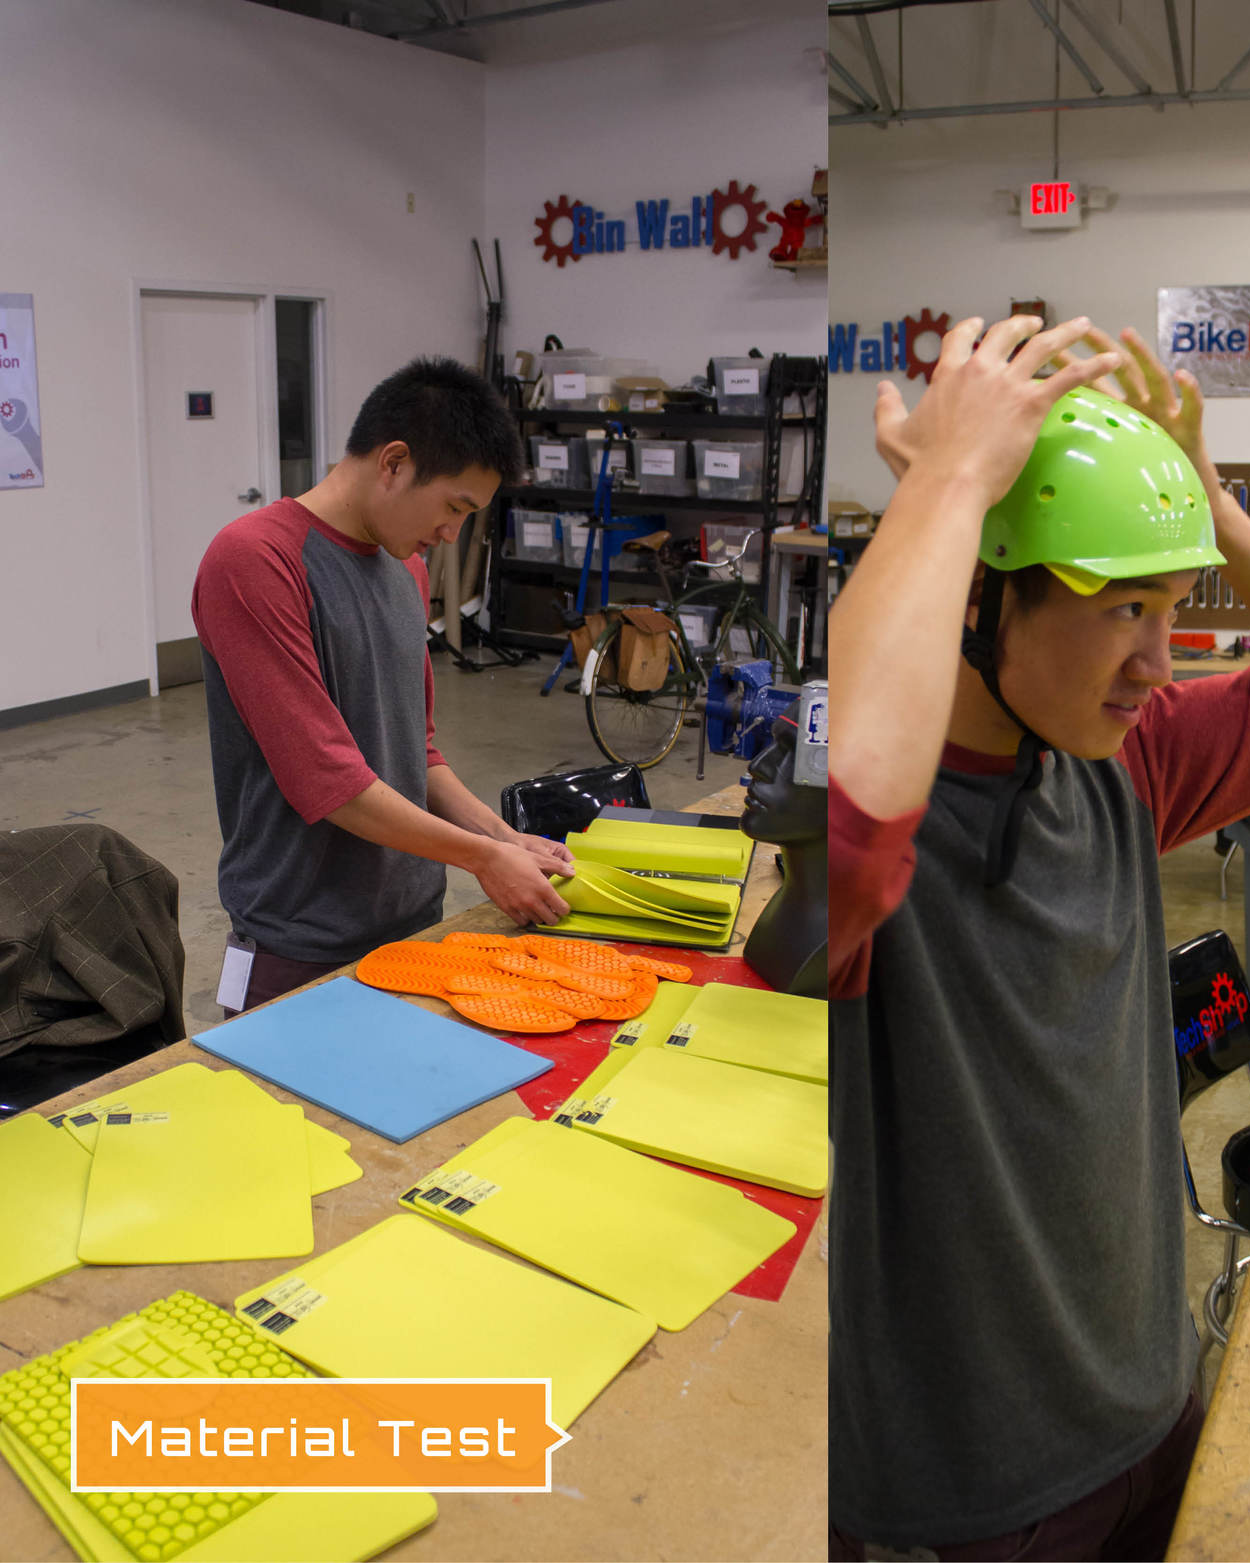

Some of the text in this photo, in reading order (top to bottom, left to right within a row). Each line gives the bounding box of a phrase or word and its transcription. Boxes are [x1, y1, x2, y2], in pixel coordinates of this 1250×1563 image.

[572, 195, 715, 255] Bin Wall
[1031, 182, 1070, 215] EXIT
[828, 321, 907, 374] Wall
